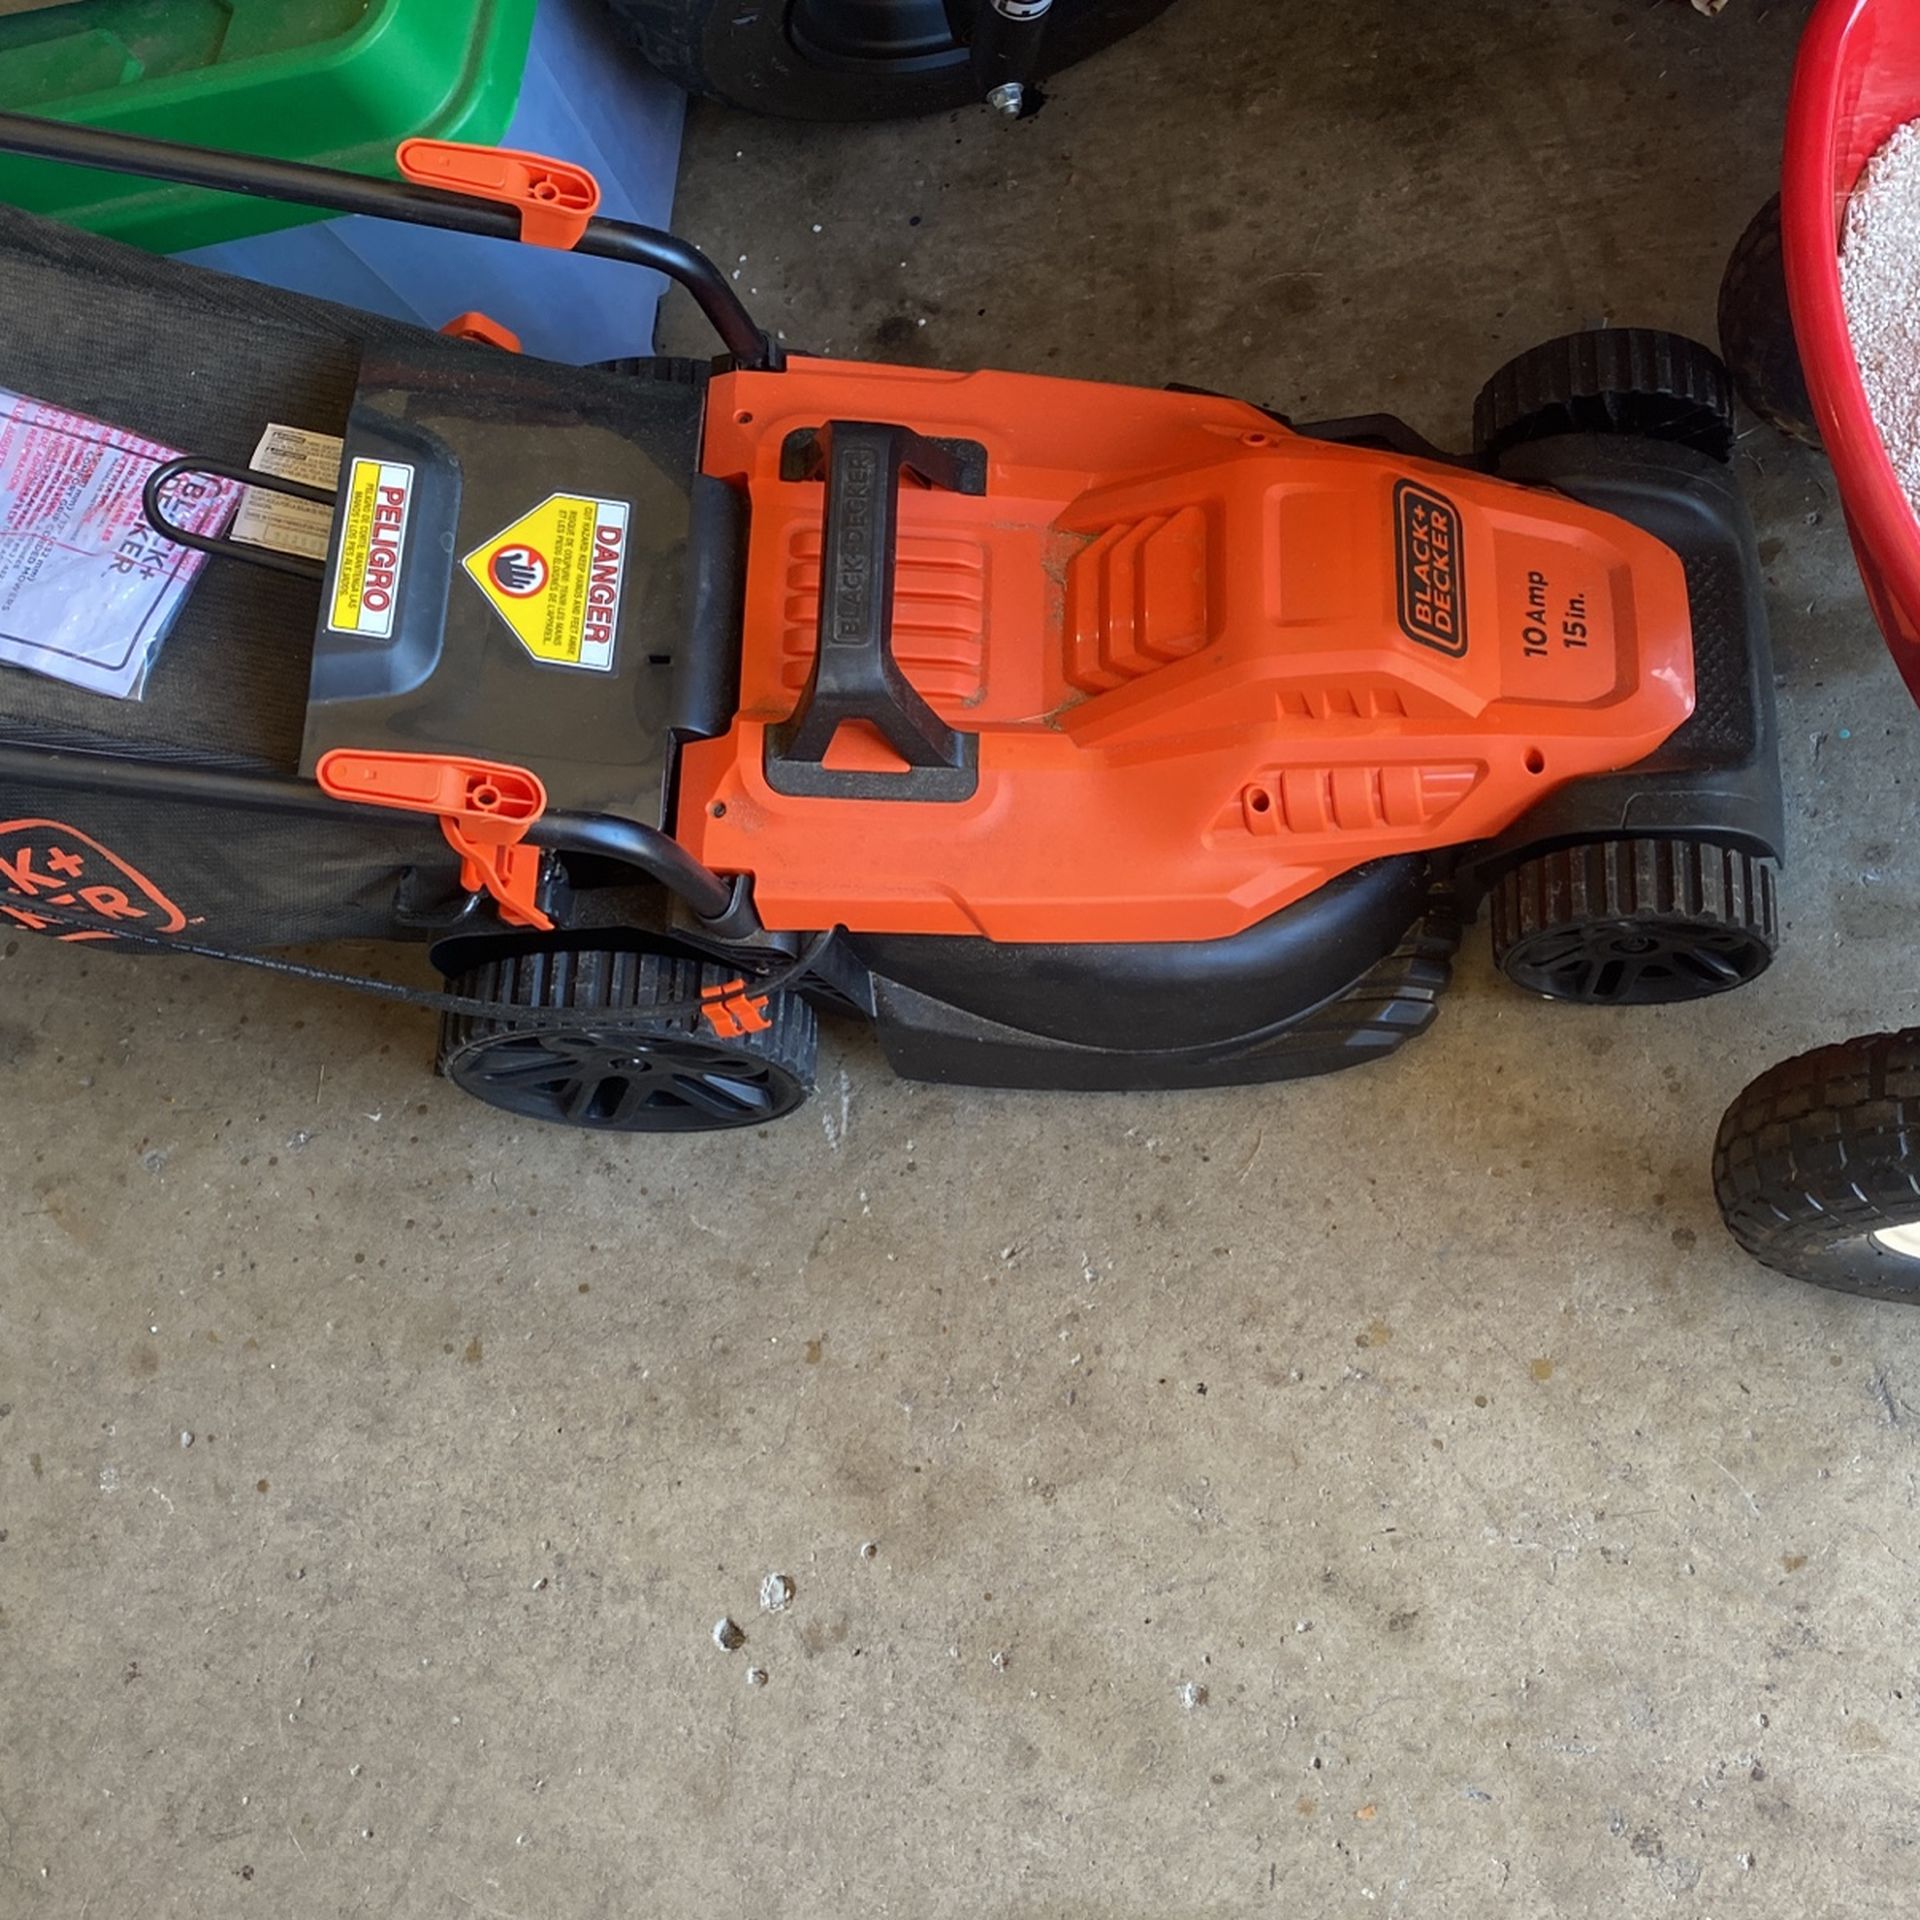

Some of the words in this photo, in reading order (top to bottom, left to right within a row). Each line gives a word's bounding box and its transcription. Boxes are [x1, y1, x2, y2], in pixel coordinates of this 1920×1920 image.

[363, 486, 405, 612] PELIGRO
[584, 525, 623, 645] DANGER
[1412, 504, 1433, 625] BLACK+
[1430, 510, 1452, 633] DECKER
[1522, 626, 1548, 657] 10
[1526, 571, 1549, 625] Amp
[1562, 620, 1587, 648] 15
[1567, 592, 1586, 620] in.
